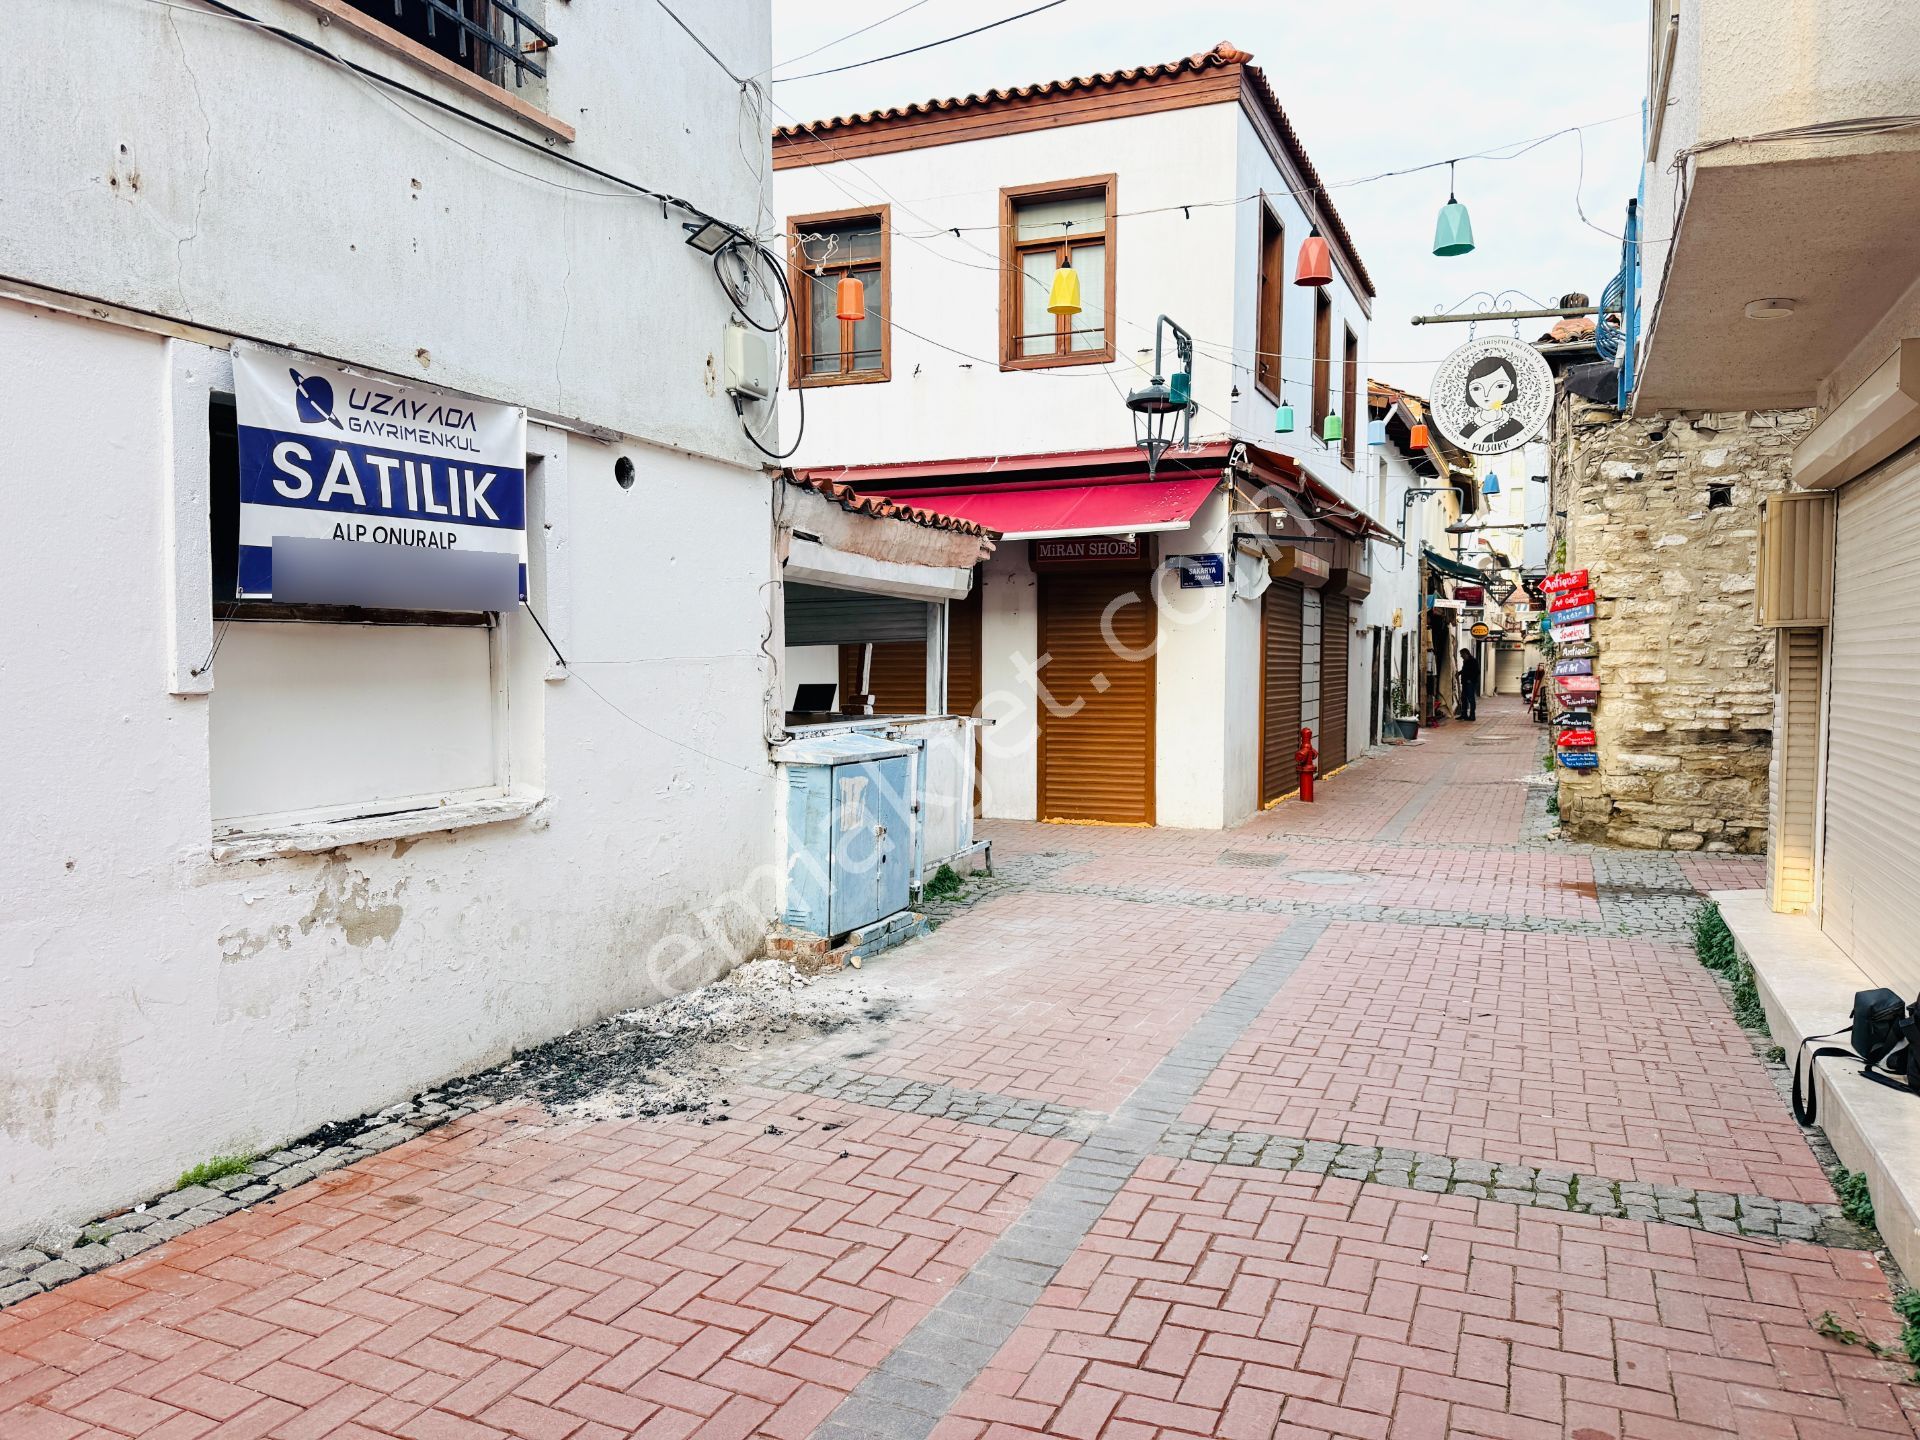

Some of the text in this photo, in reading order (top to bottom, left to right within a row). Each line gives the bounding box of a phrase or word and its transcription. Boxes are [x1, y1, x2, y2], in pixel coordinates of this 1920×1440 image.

[349, 388, 427, 420] UZAY
[349, 417, 481, 453] GAYRİMENKUL
[272, 440, 501, 521] SATILIK
[332, 522, 458, 550] ALP ONURALP
[1089, 541, 1137, 556] SHOES
[1189, 567, 1216, 575] SAKARYA
[1543, 573, 1578, 591] Antique
